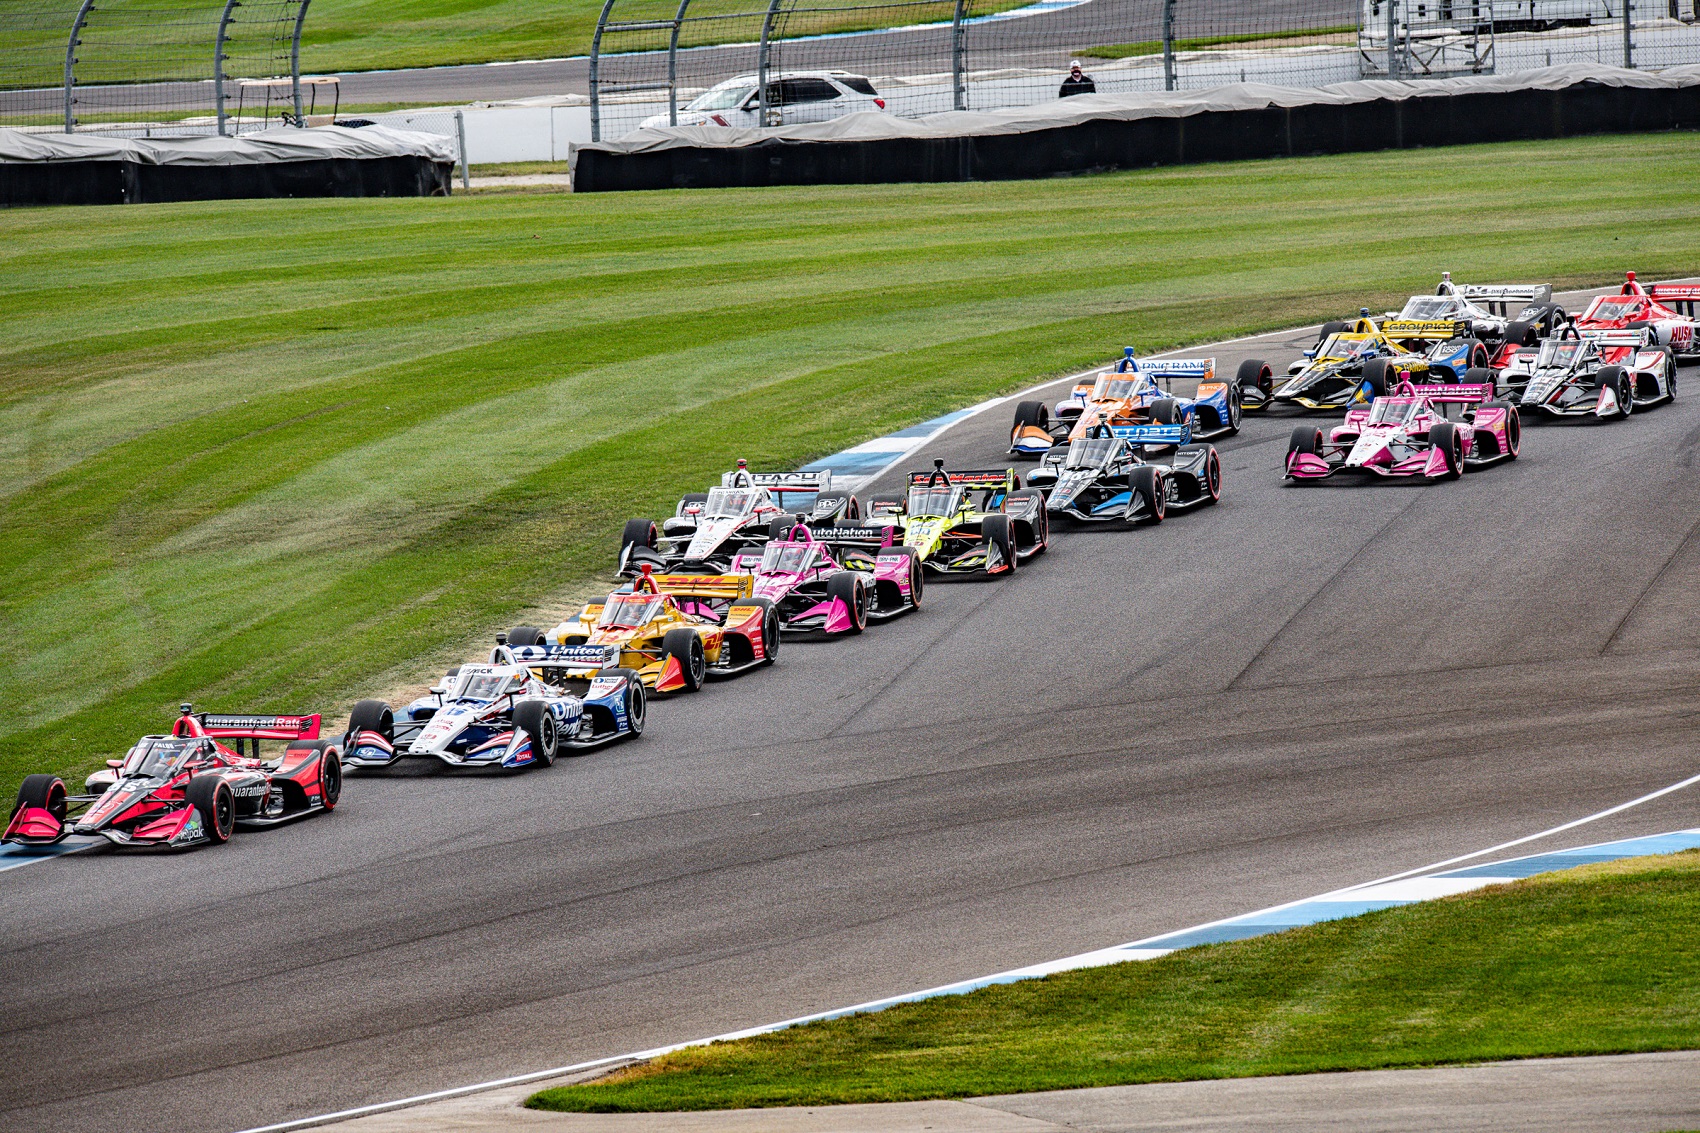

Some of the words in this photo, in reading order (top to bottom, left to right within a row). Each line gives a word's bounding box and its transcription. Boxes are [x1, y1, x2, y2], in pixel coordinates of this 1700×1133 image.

[1415, 385, 1481, 395] utoNation
[751, 472, 817, 482] ITACH
[811, 528, 873, 537] utoNation
[666, 577, 726, 587] DHL
[516, 753, 532, 761] TOTAL
